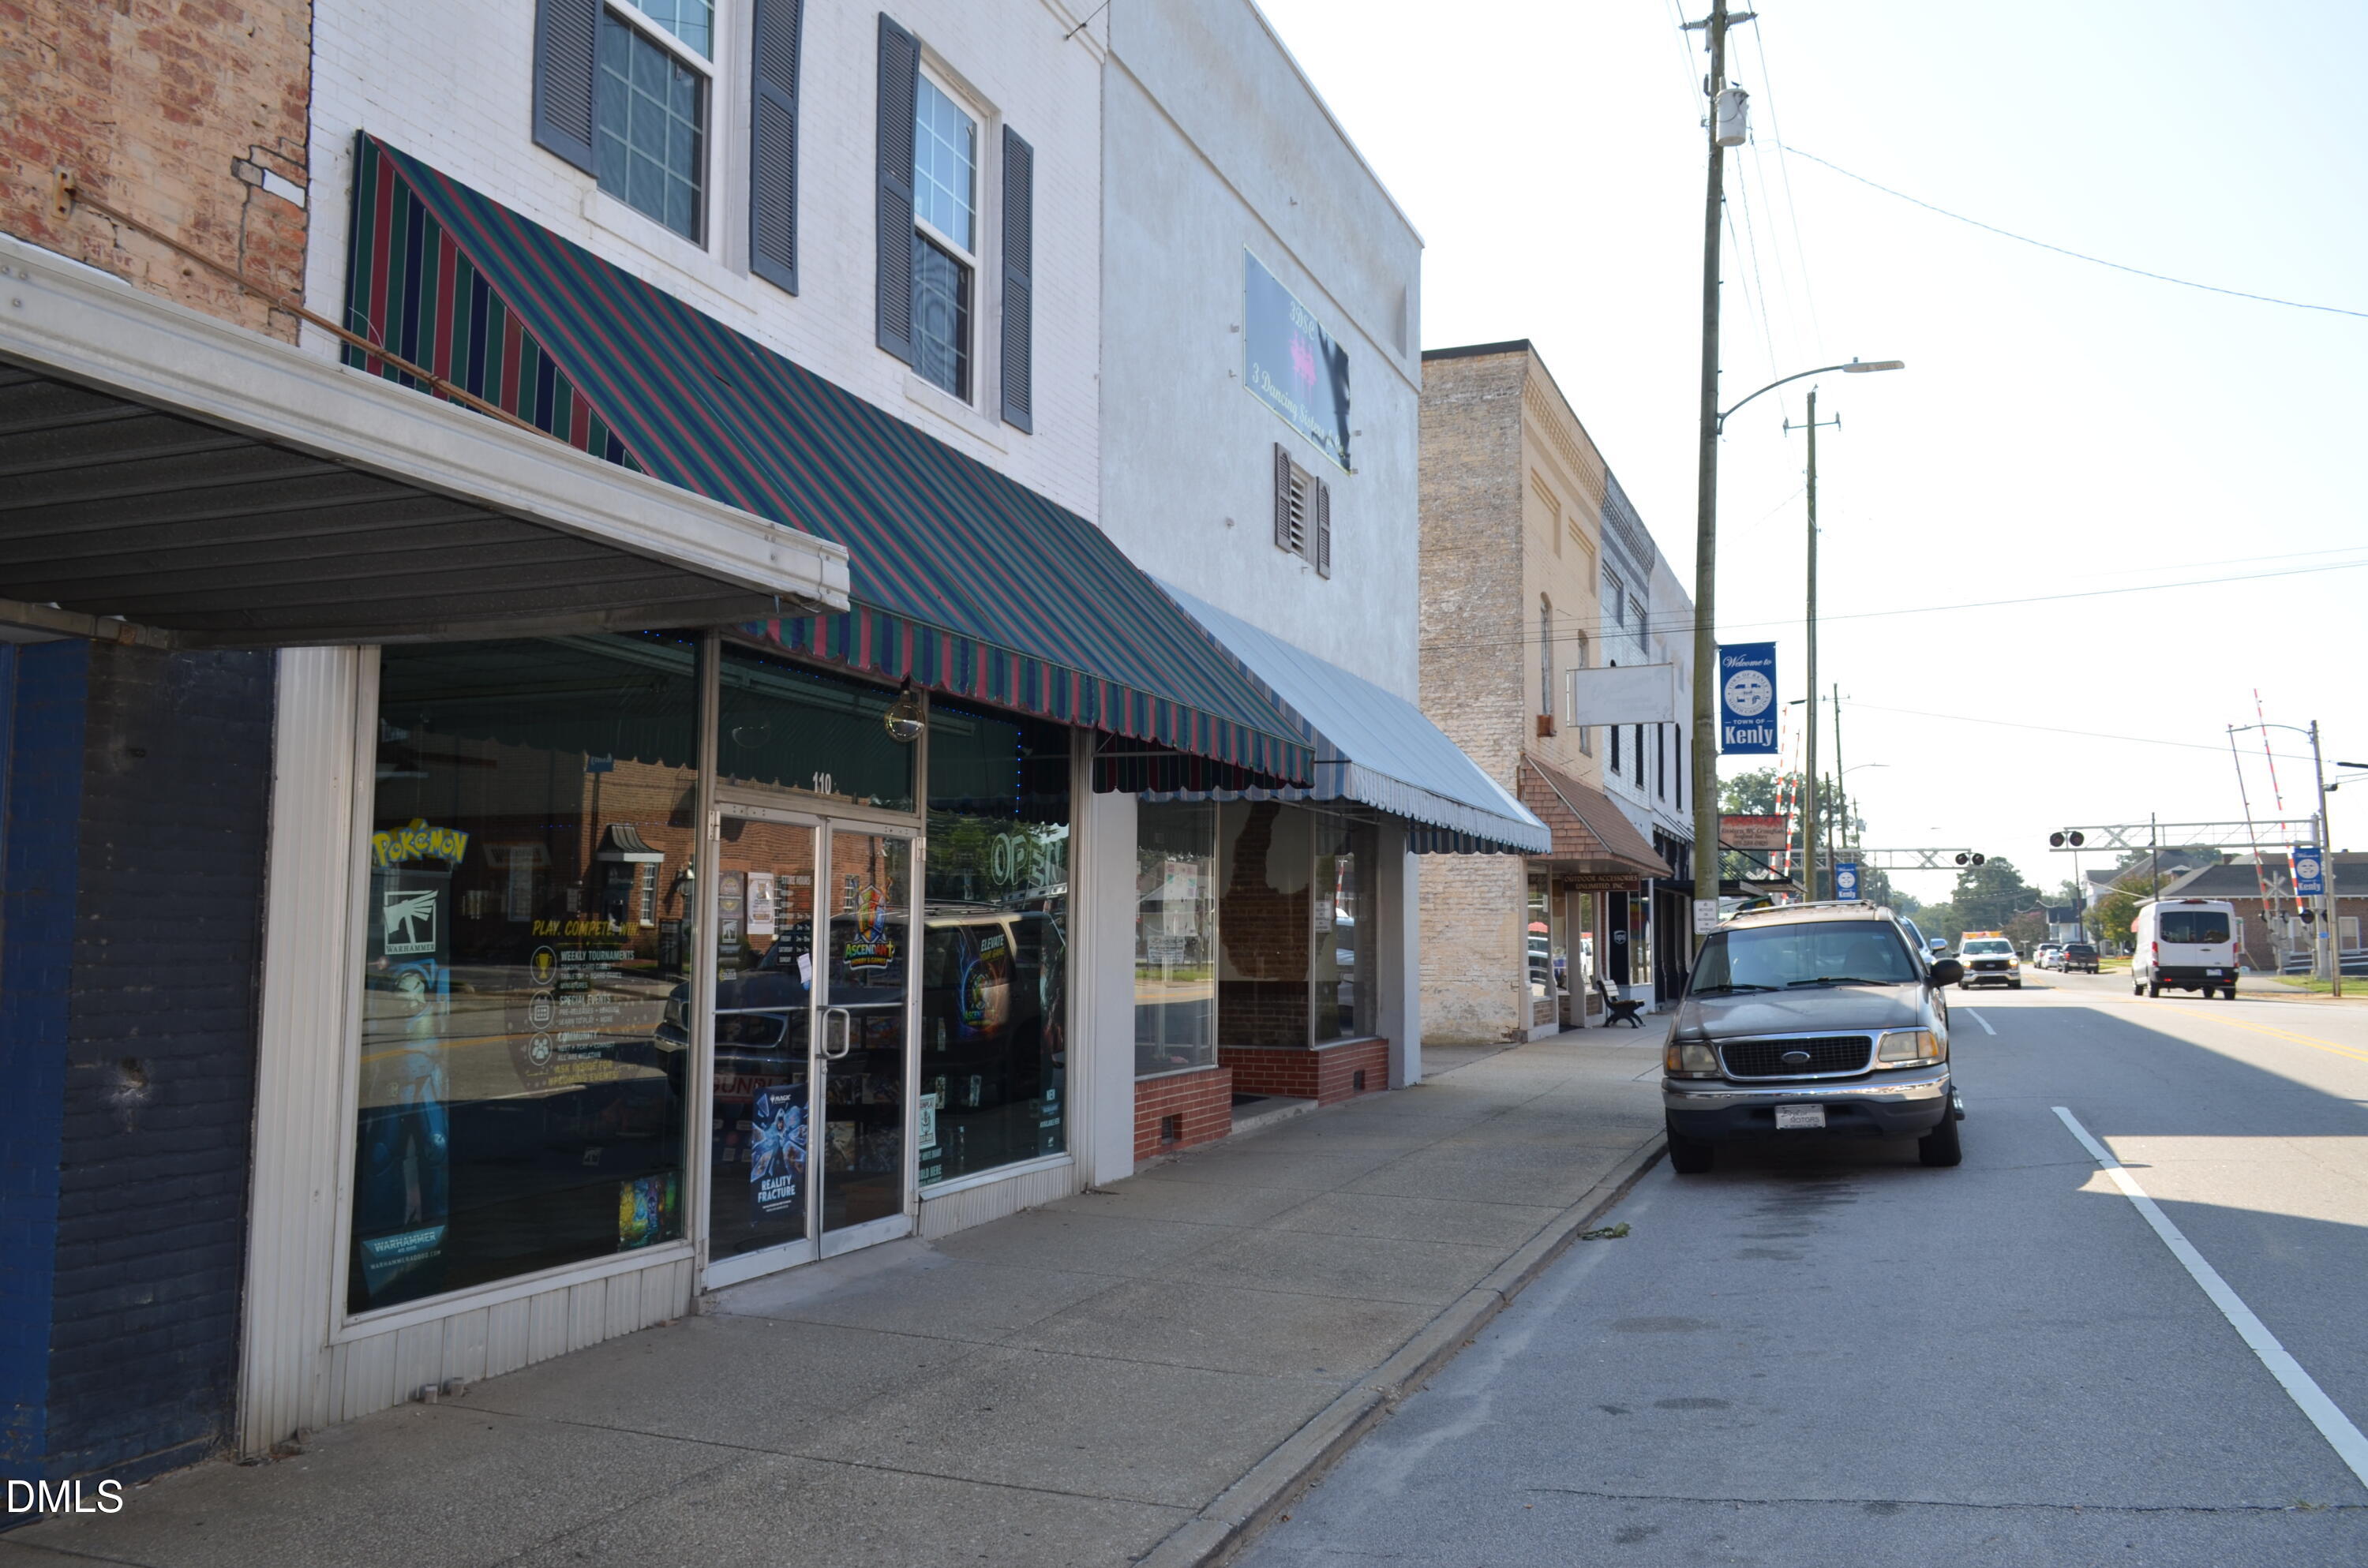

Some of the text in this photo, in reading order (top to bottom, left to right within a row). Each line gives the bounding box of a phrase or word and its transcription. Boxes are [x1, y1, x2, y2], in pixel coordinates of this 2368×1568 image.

[1290, 301, 1315, 340] 3DSC
[1252, 362, 1260, 384] 3
[1261, 371, 1298, 421] Dancing
[1299, 406, 1325, 438] Sisters
[1723, 654, 1773, 668] Welcome to
[1725, 725, 1774, 747] Kenly
[812, 771, 832, 795] 110
[991, 833, 1063, 887] OPEN
[2298, 882, 2321, 891] Kenly
[531, 919, 560, 936] PLAY.
[386, 944, 435, 953] WARHAMMER
[980, 934, 1005, 952] ELEVATE
[560, 950, 635, 961] WEEKLY TOURNAMENTS
[559, 994, 611, 1005] SPECIAL EVENTS
[557, 1031, 598, 1042] COMMUNITY
[555, 1060, 613, 1073] ASK INSIDE FOR
[548, 1073, 589, 1087] UPCOMING
[761, 1174, 792, 1191] REALITY
[758, 1184, 796, 1203] FRACTURE
[374, 1231, 436, 1252] WARHAMMER
